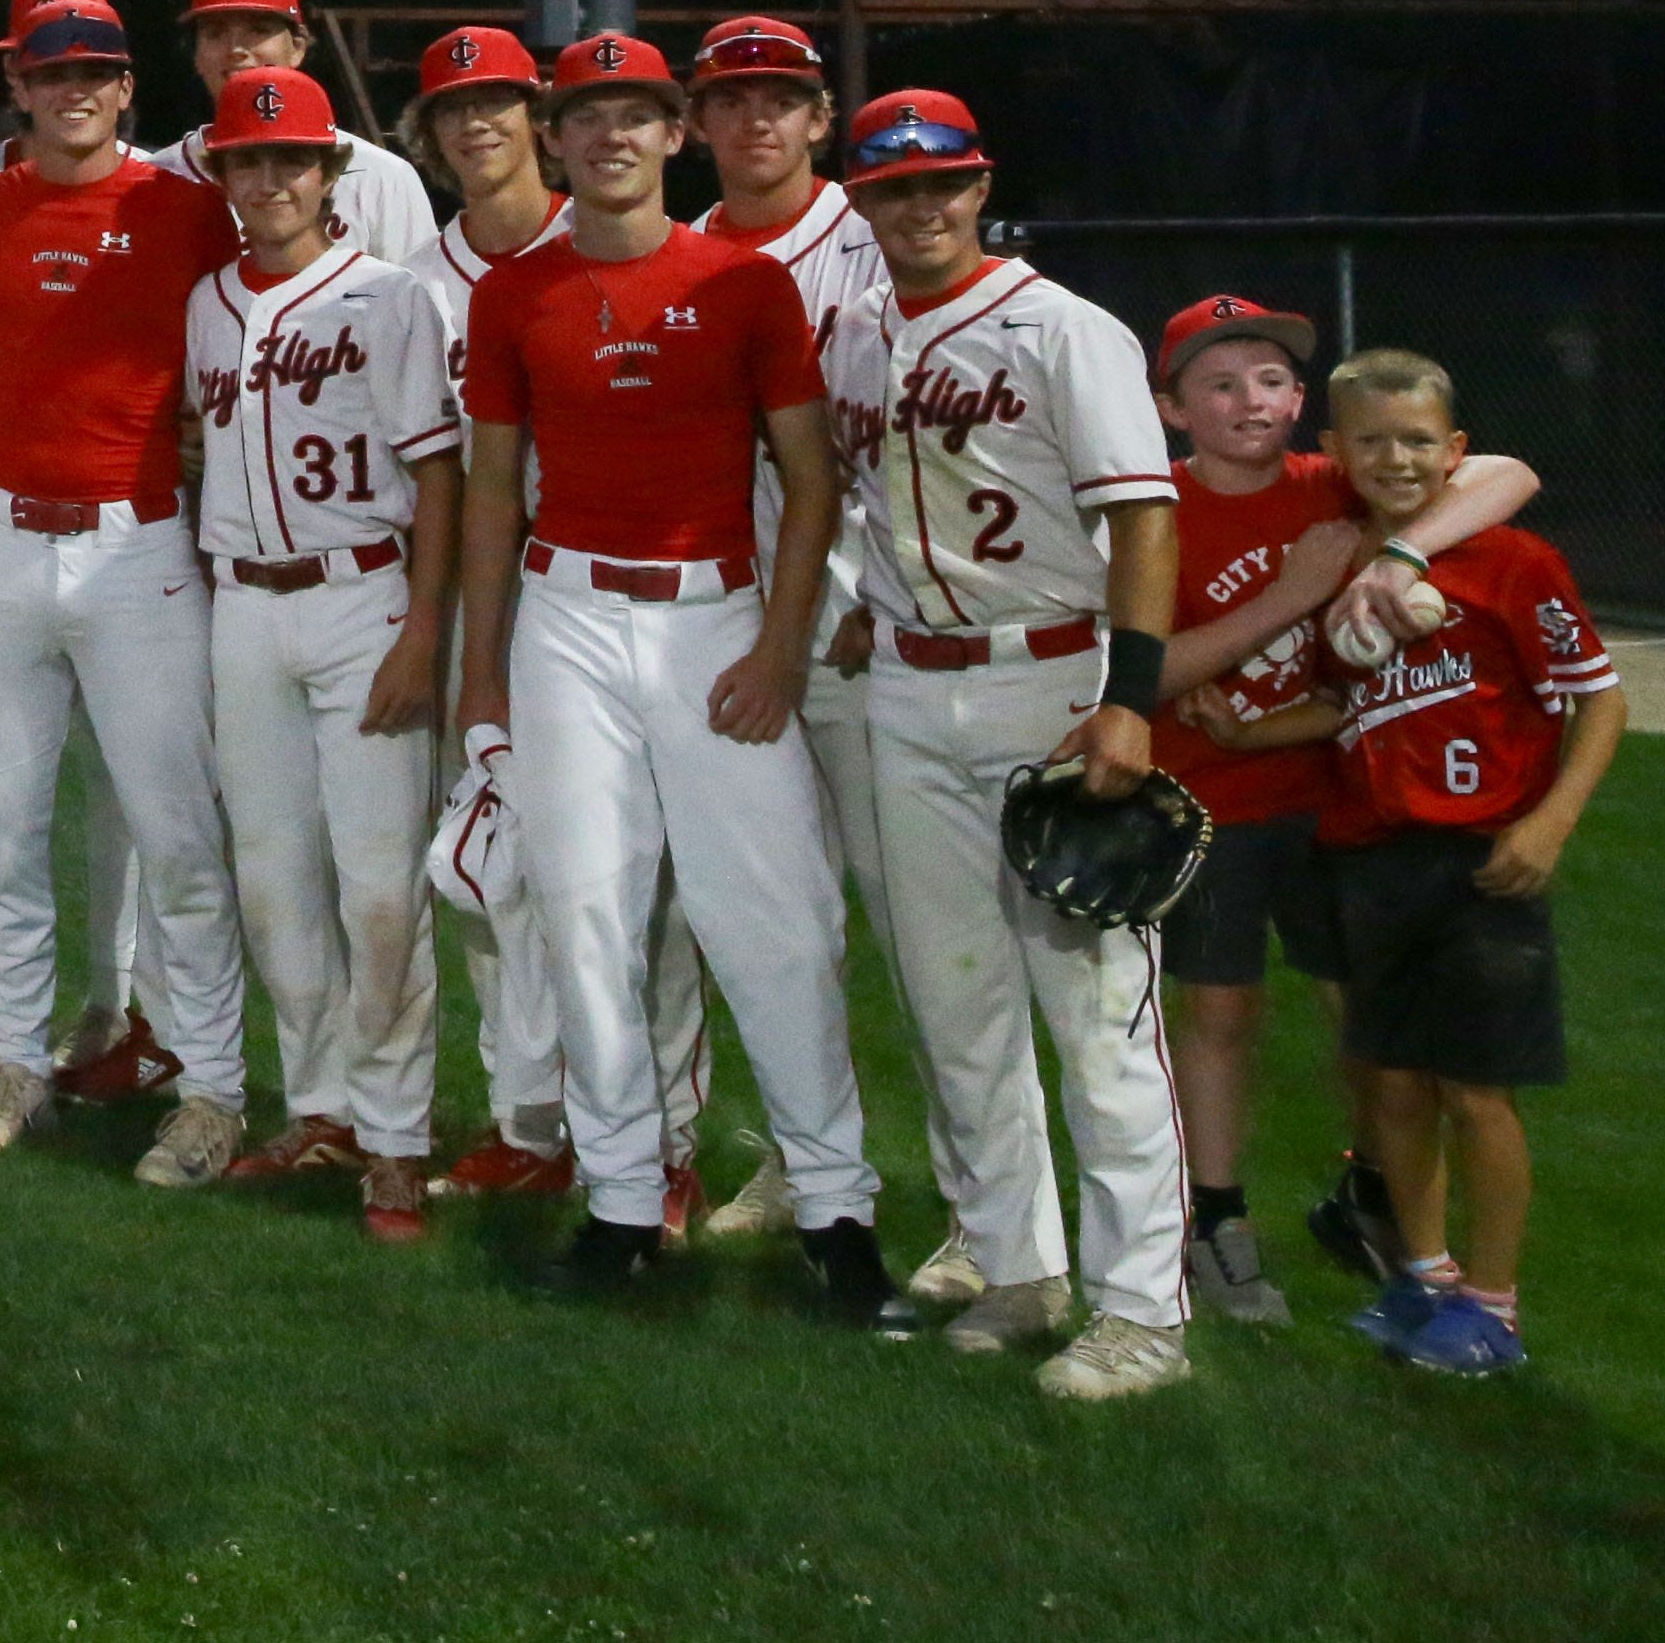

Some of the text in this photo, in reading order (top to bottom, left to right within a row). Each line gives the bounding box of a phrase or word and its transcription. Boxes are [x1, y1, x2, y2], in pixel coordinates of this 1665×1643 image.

[245, 325, 368, 406] High
[594, 341, 660, 360] LITTLE HAWKS
[892, 366, 1027, 455] High
[292, 433, 376, 503] 31
[968, 488, 1025, 563] 2
[1206, 545, 1269, 603] CITY
[1373, 645, 1473, 702] Hawks
[1444, 738, 1479, 794] 6
